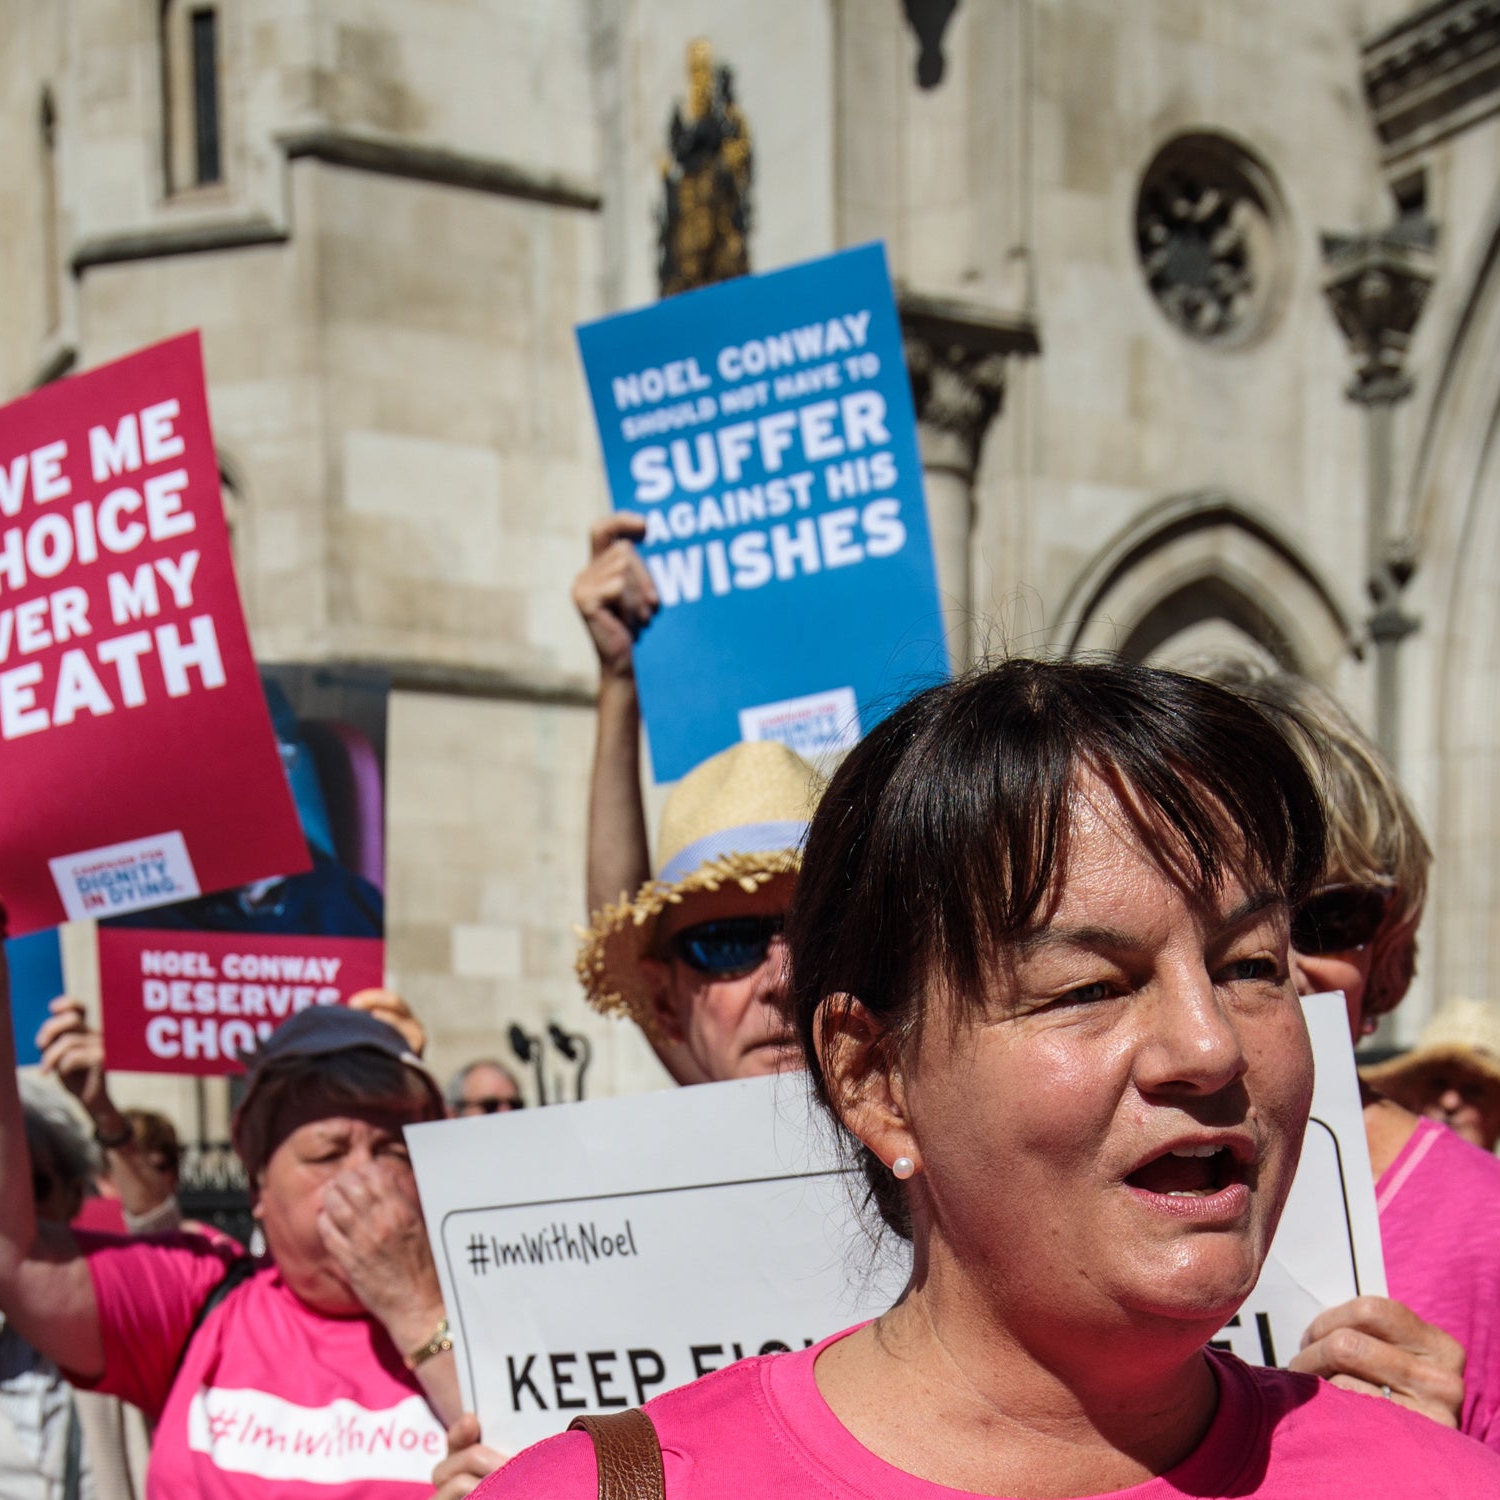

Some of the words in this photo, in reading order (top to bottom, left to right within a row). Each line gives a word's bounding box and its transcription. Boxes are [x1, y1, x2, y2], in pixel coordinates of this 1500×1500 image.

[613, 358, 711, 410] NOEL
[718, 310, 871, 381] CONWAY
[622, 397, 717, 441] SHOULD
[721, 383, 769, 414] NOT
[775, 362, 841, 400] HAVE
[846, 353, 880, 380] TO
[89, 399, 185, 482] ME
[631, 391, 890, 502] SUFFER
[645, 473, 814, 546] AGAINST
[826, 453, 897, 500] HIS
[107, 550, 200, 625] MY
[650, 499, 907, 607] WISHES
[77, 858, 166, 893] DIGNITY
[141, 950, 215, 978] NOEL
[222, 953, 340, 982] CONWAY
[466, 1219, 638, 1275] #ImWithNoel
[507, 1348, 665, 1411] KEEP
